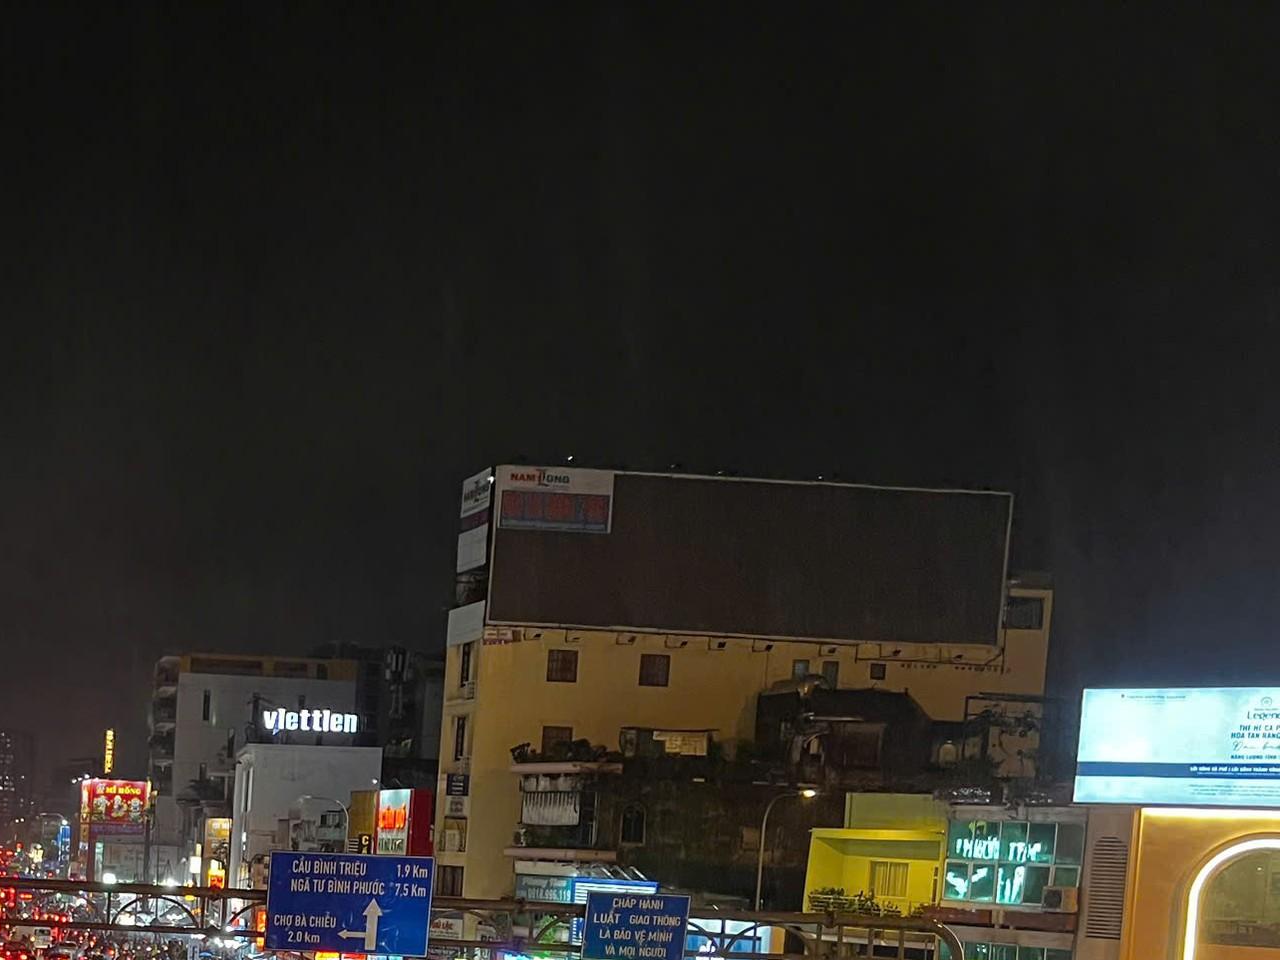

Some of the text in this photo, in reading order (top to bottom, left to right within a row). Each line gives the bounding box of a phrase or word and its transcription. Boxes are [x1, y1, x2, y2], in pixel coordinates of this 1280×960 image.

[313, 858, 337, 875] BÌNH
[339, 861, 367, 877] TRIỆU
[396, 864, 410, 878] 1.9
[412, 864, 428, 878] Km
[290, 878, 311, 893] NGÃ
[327, 879, 351, 894] BÌNH
[410, 884, 427, 897] Km
[274, 914, 294, 928] CHỢ
[294, 913, 307, 927] BÀ
[629, 914, 650, 925] GIAO
[304, 930, 320, 943] km
[599, 926, 611, 939] LÀ
